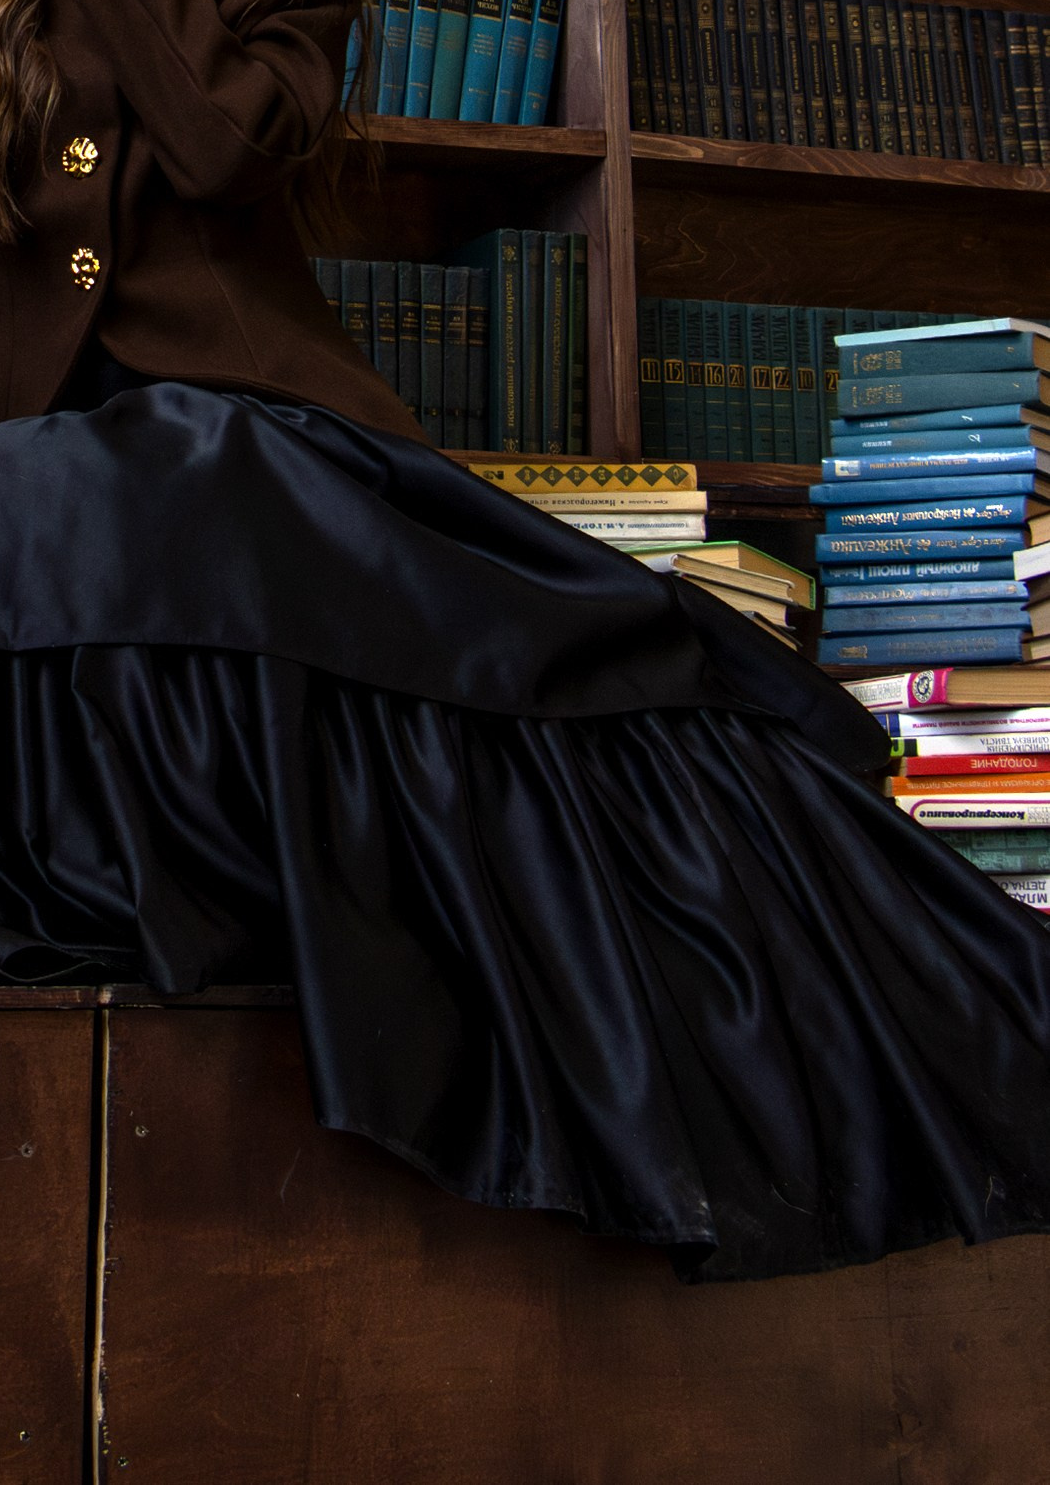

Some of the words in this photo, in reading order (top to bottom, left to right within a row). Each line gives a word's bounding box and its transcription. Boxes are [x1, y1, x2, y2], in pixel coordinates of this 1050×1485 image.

[668, 362, 681, 379] 15
[708, 366, 721, 383] 16
[756, 369, 768, 386] 17
[776, 369, 790, 387] 22
[968, 434, 981, 443] 2
[552, 499, 616, 507] Нижегородская
[980, 737, 1012, 746] ТВИСТА
[1013, 737, 1049, 746] ОЛИВЕРА
[987, 743, 1050, 752] ПРИКЛЮЧЕНИЯ
[970, 758, 1037, 769] ГОЛОДАНИЕ
